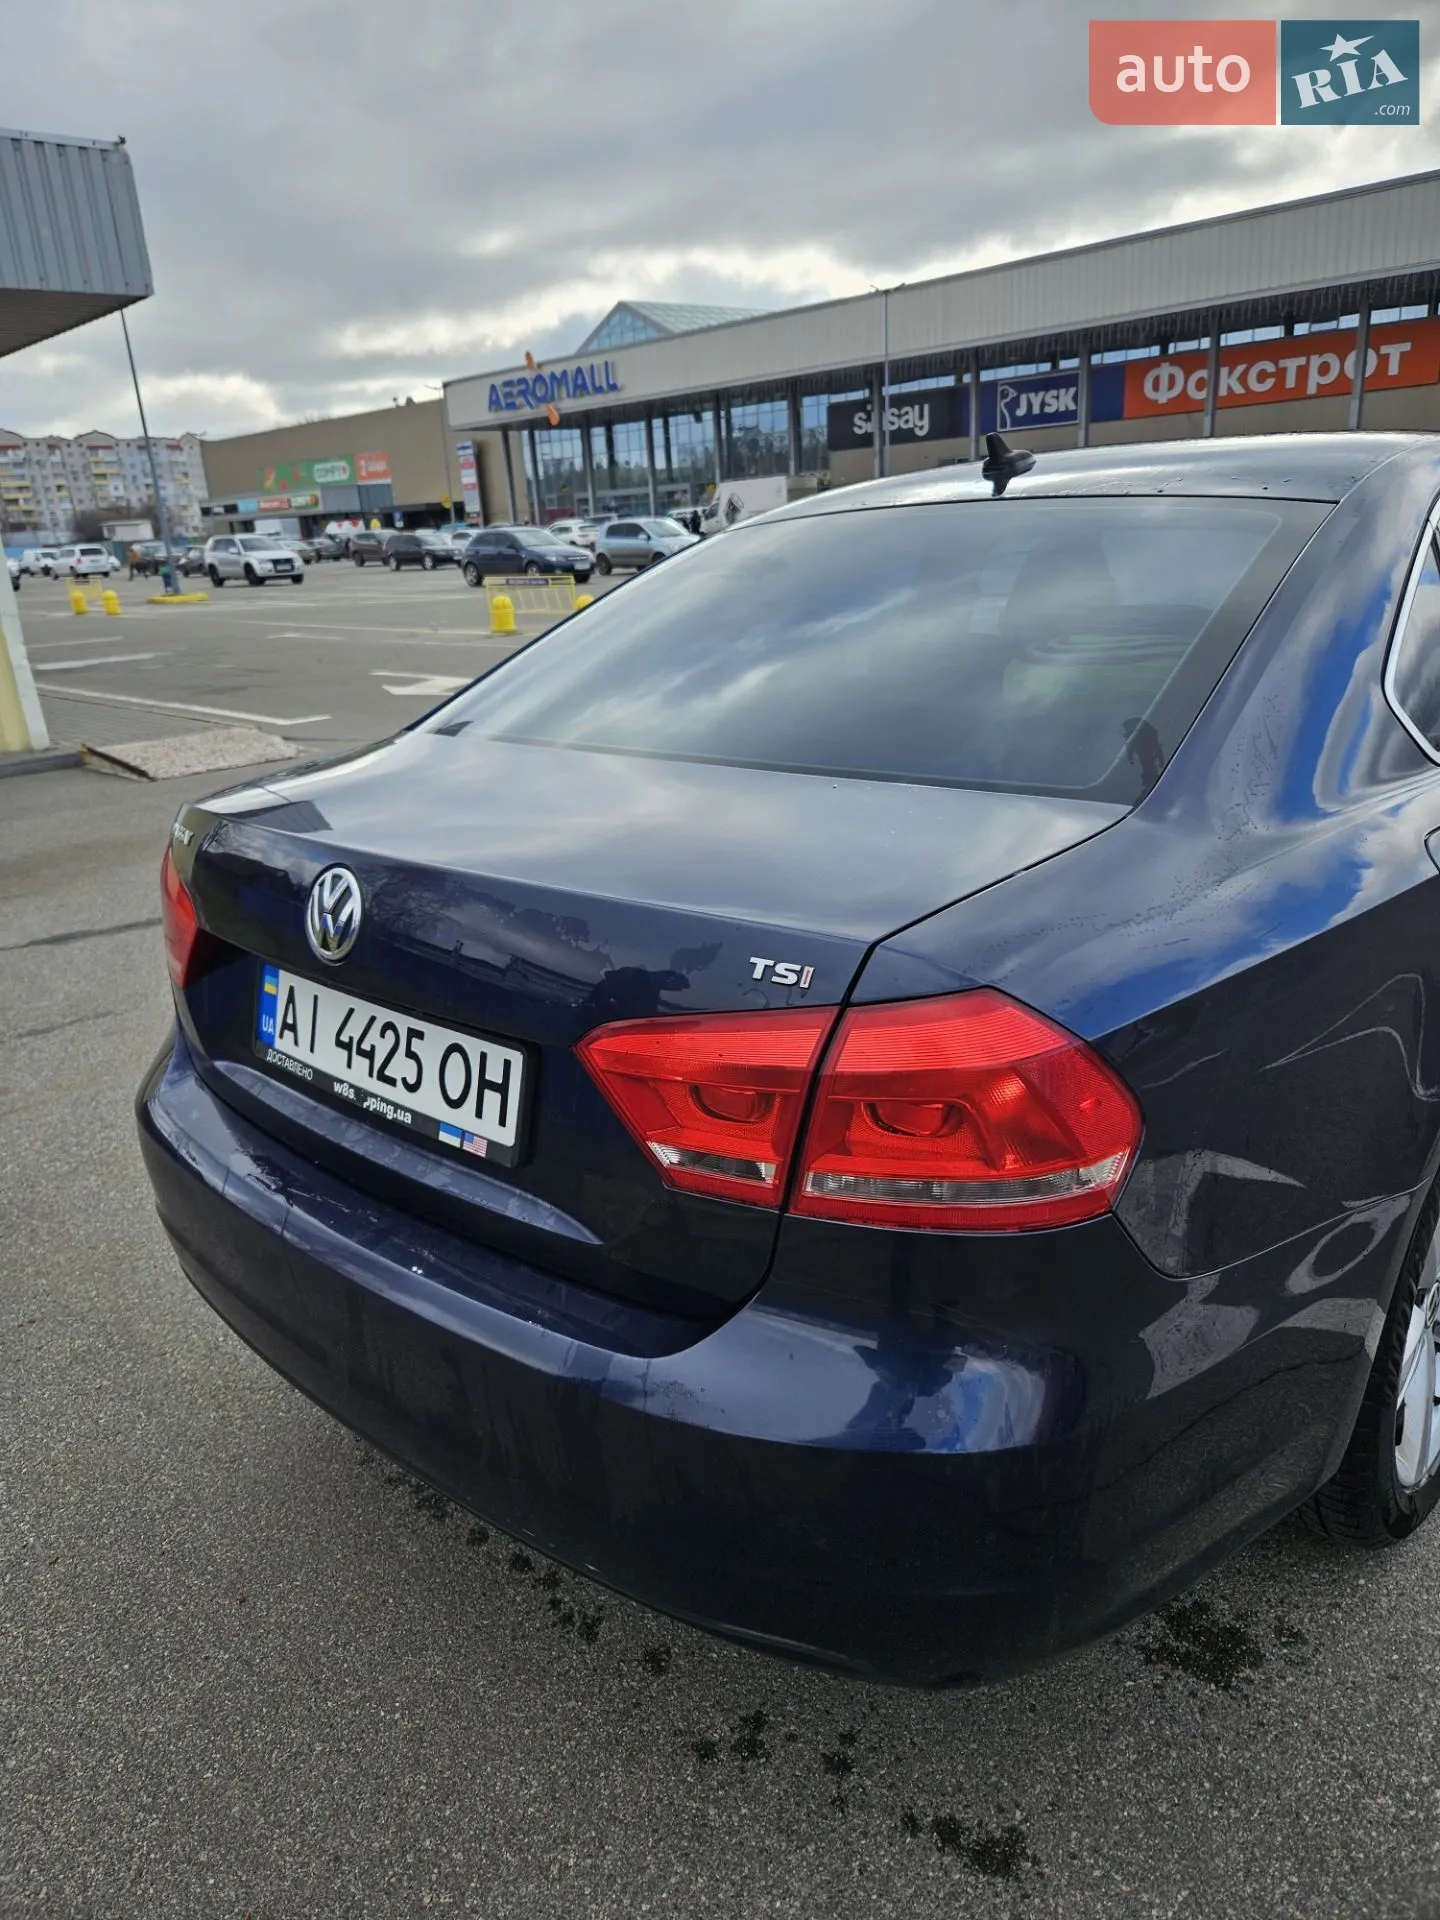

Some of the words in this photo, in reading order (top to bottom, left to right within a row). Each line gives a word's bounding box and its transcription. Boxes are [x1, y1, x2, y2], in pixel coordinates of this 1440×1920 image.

[488, 360, 619, 412] AEROMALL
[1143, 342, 1412, 404] Фокстрот
[1015, 387, 1078, 417] JYSK
[749, 956, 815, 989] TSI
[262, 1014, 275, 1036] UA
[266, 1049, 313, 1081] ДОСТАВЛЕНО
[278, 985, 318, 1054] AI
[335, 1007, 425, 1093] 4425
[439, 1042, 511, 1128] OH
